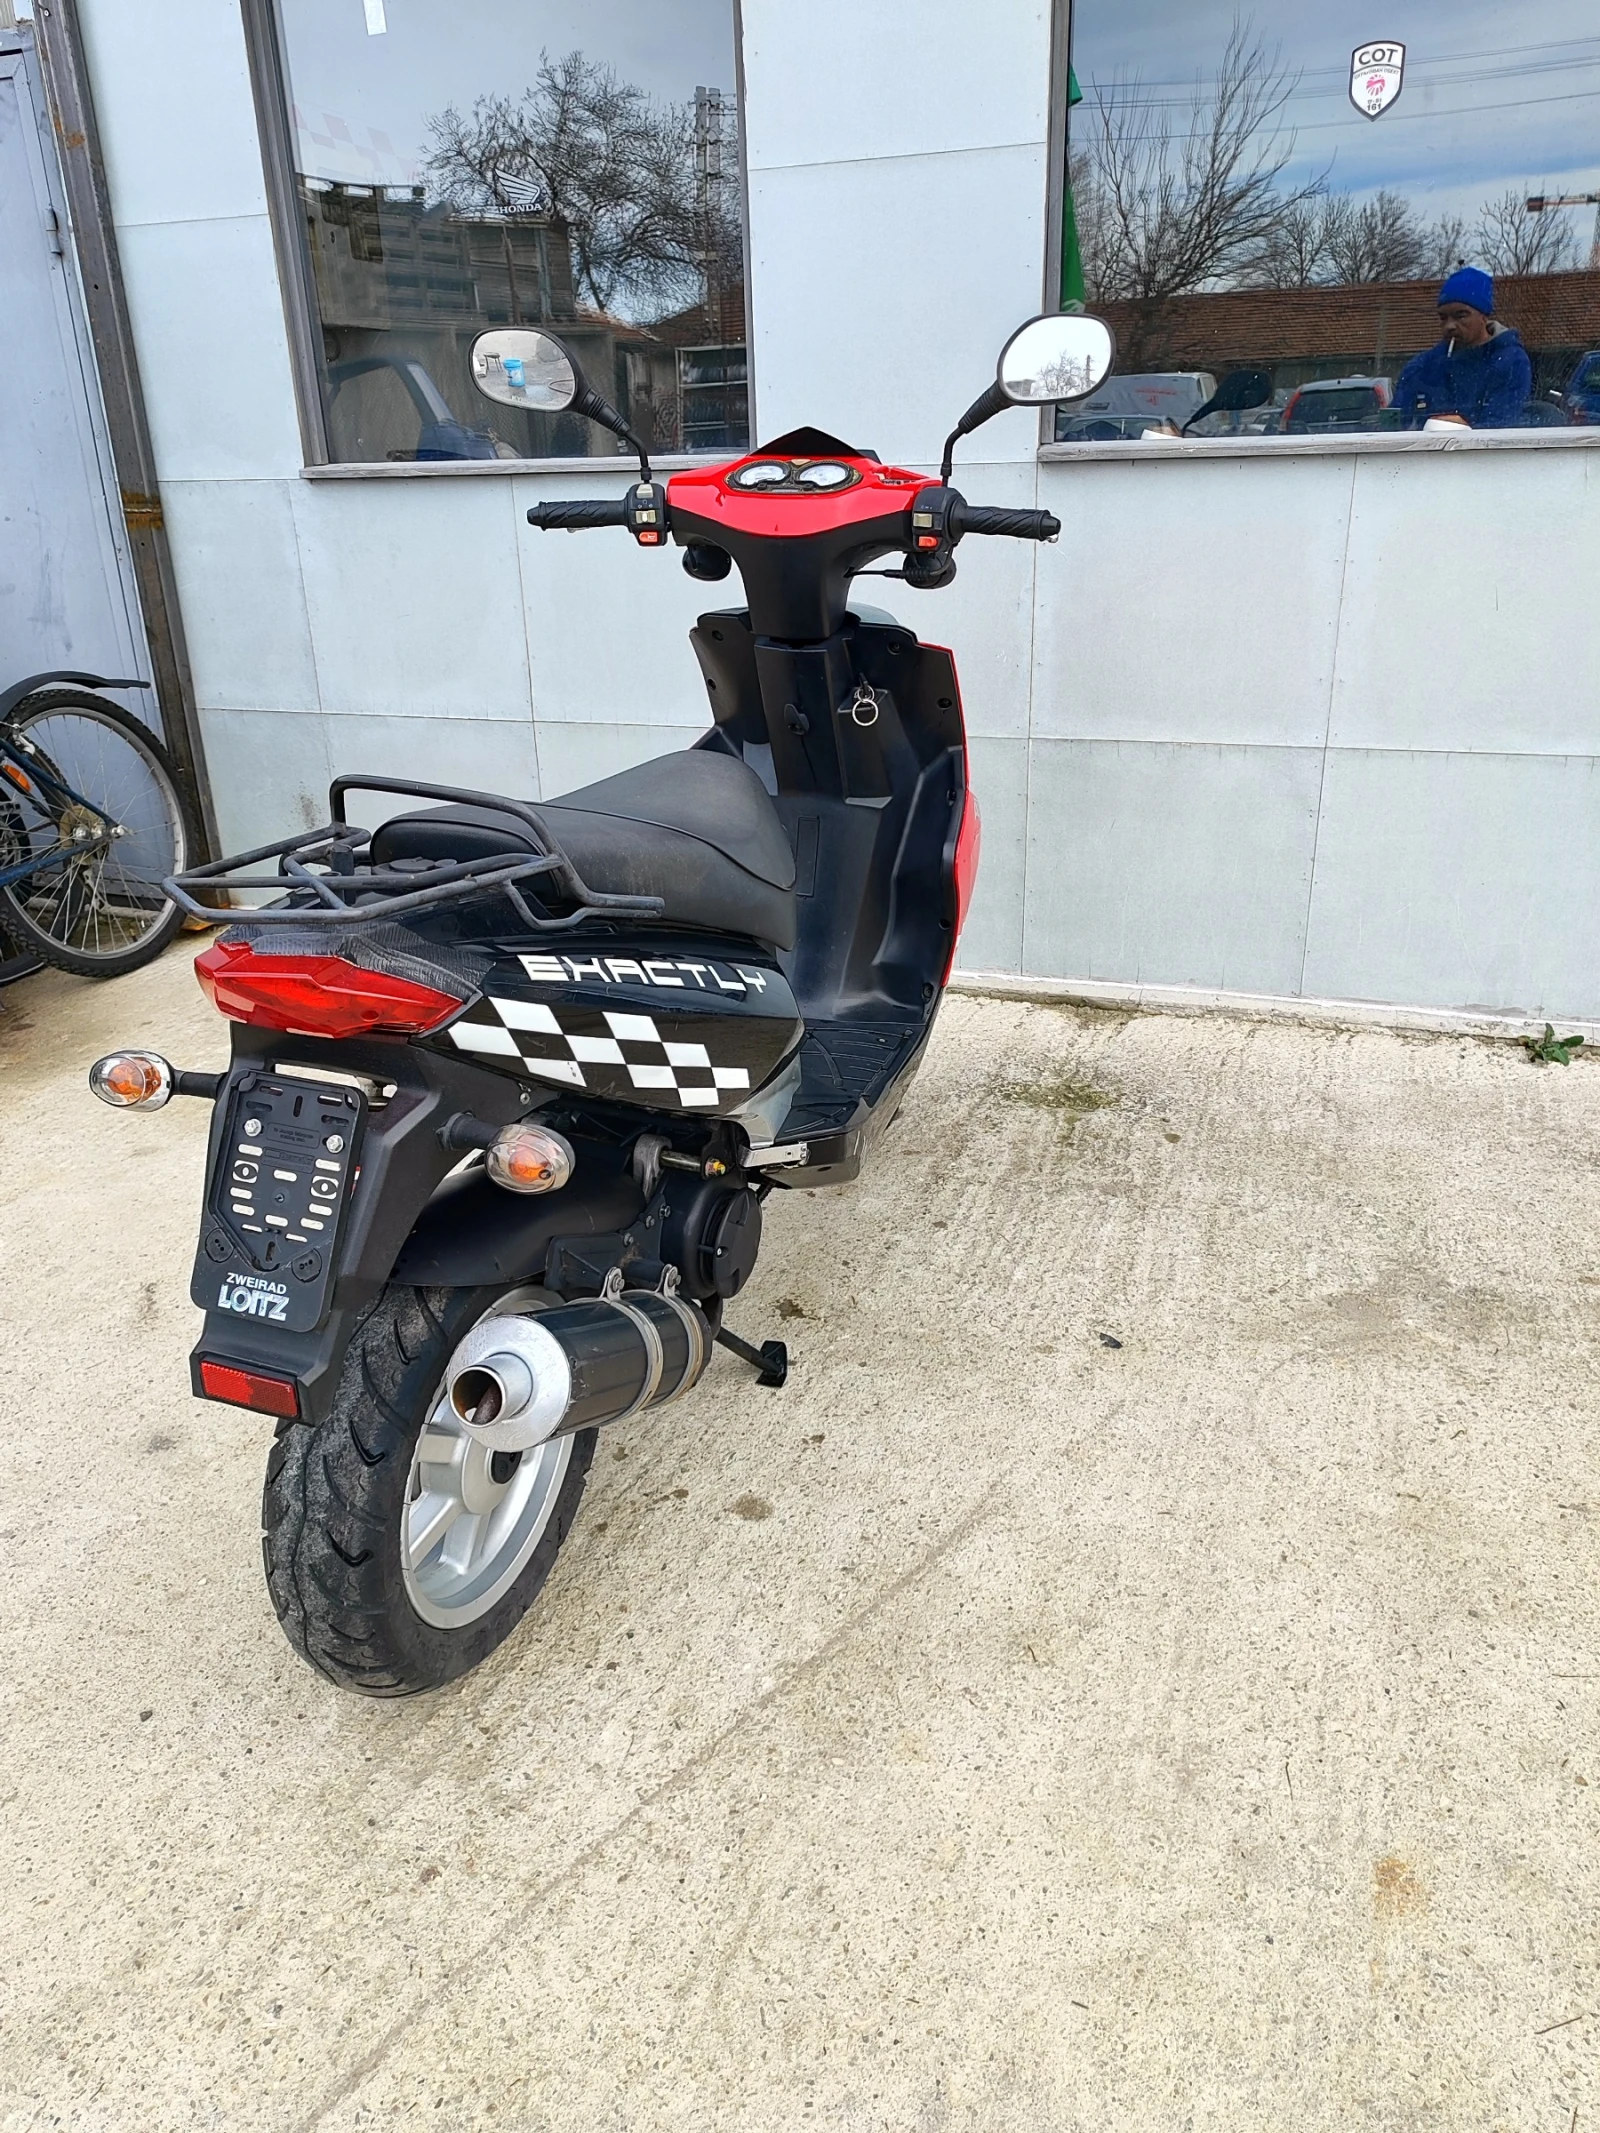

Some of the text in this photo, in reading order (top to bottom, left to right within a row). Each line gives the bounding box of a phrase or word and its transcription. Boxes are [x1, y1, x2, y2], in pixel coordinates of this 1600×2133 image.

[1359, 48, 1398, 65] СОТ
[1367, 103, 1381, 111] 161
[499, 203, 543, 213] HONDA
[516, 954, 767, 994] EXACTLY
[226, 1272, 287, 1295] ZWEIRAD
[217, 1284, 290, 1322] LOITZ
